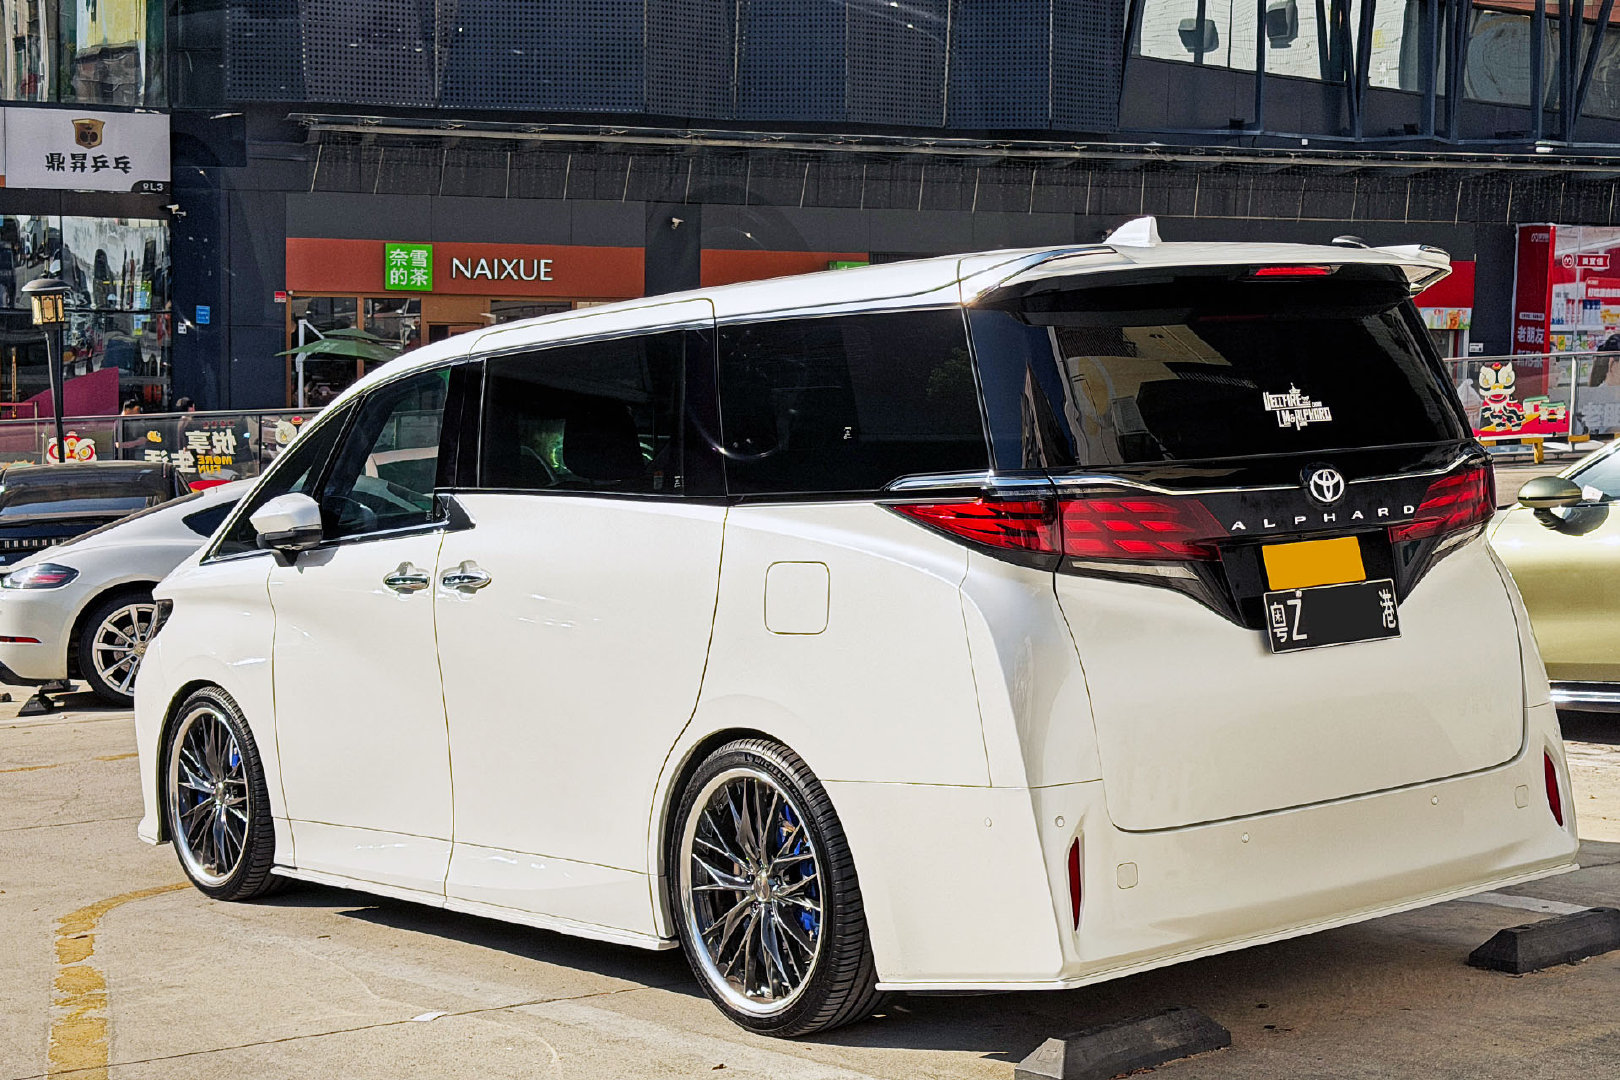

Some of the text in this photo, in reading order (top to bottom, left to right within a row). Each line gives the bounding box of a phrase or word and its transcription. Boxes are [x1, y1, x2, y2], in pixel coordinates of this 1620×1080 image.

[150, 183, 164, 191] L3
[389, 249, 428, 267] 奈雪
[389, 268, 428, 286] 的茶
[452, 257, 553, 281] NAIXUE
[1517, 325, 1545, 344] 老朋友
[1231, 505, 1415, 531] ALPHARD
[1270, 588, 1397, 643] 粤Z 港
